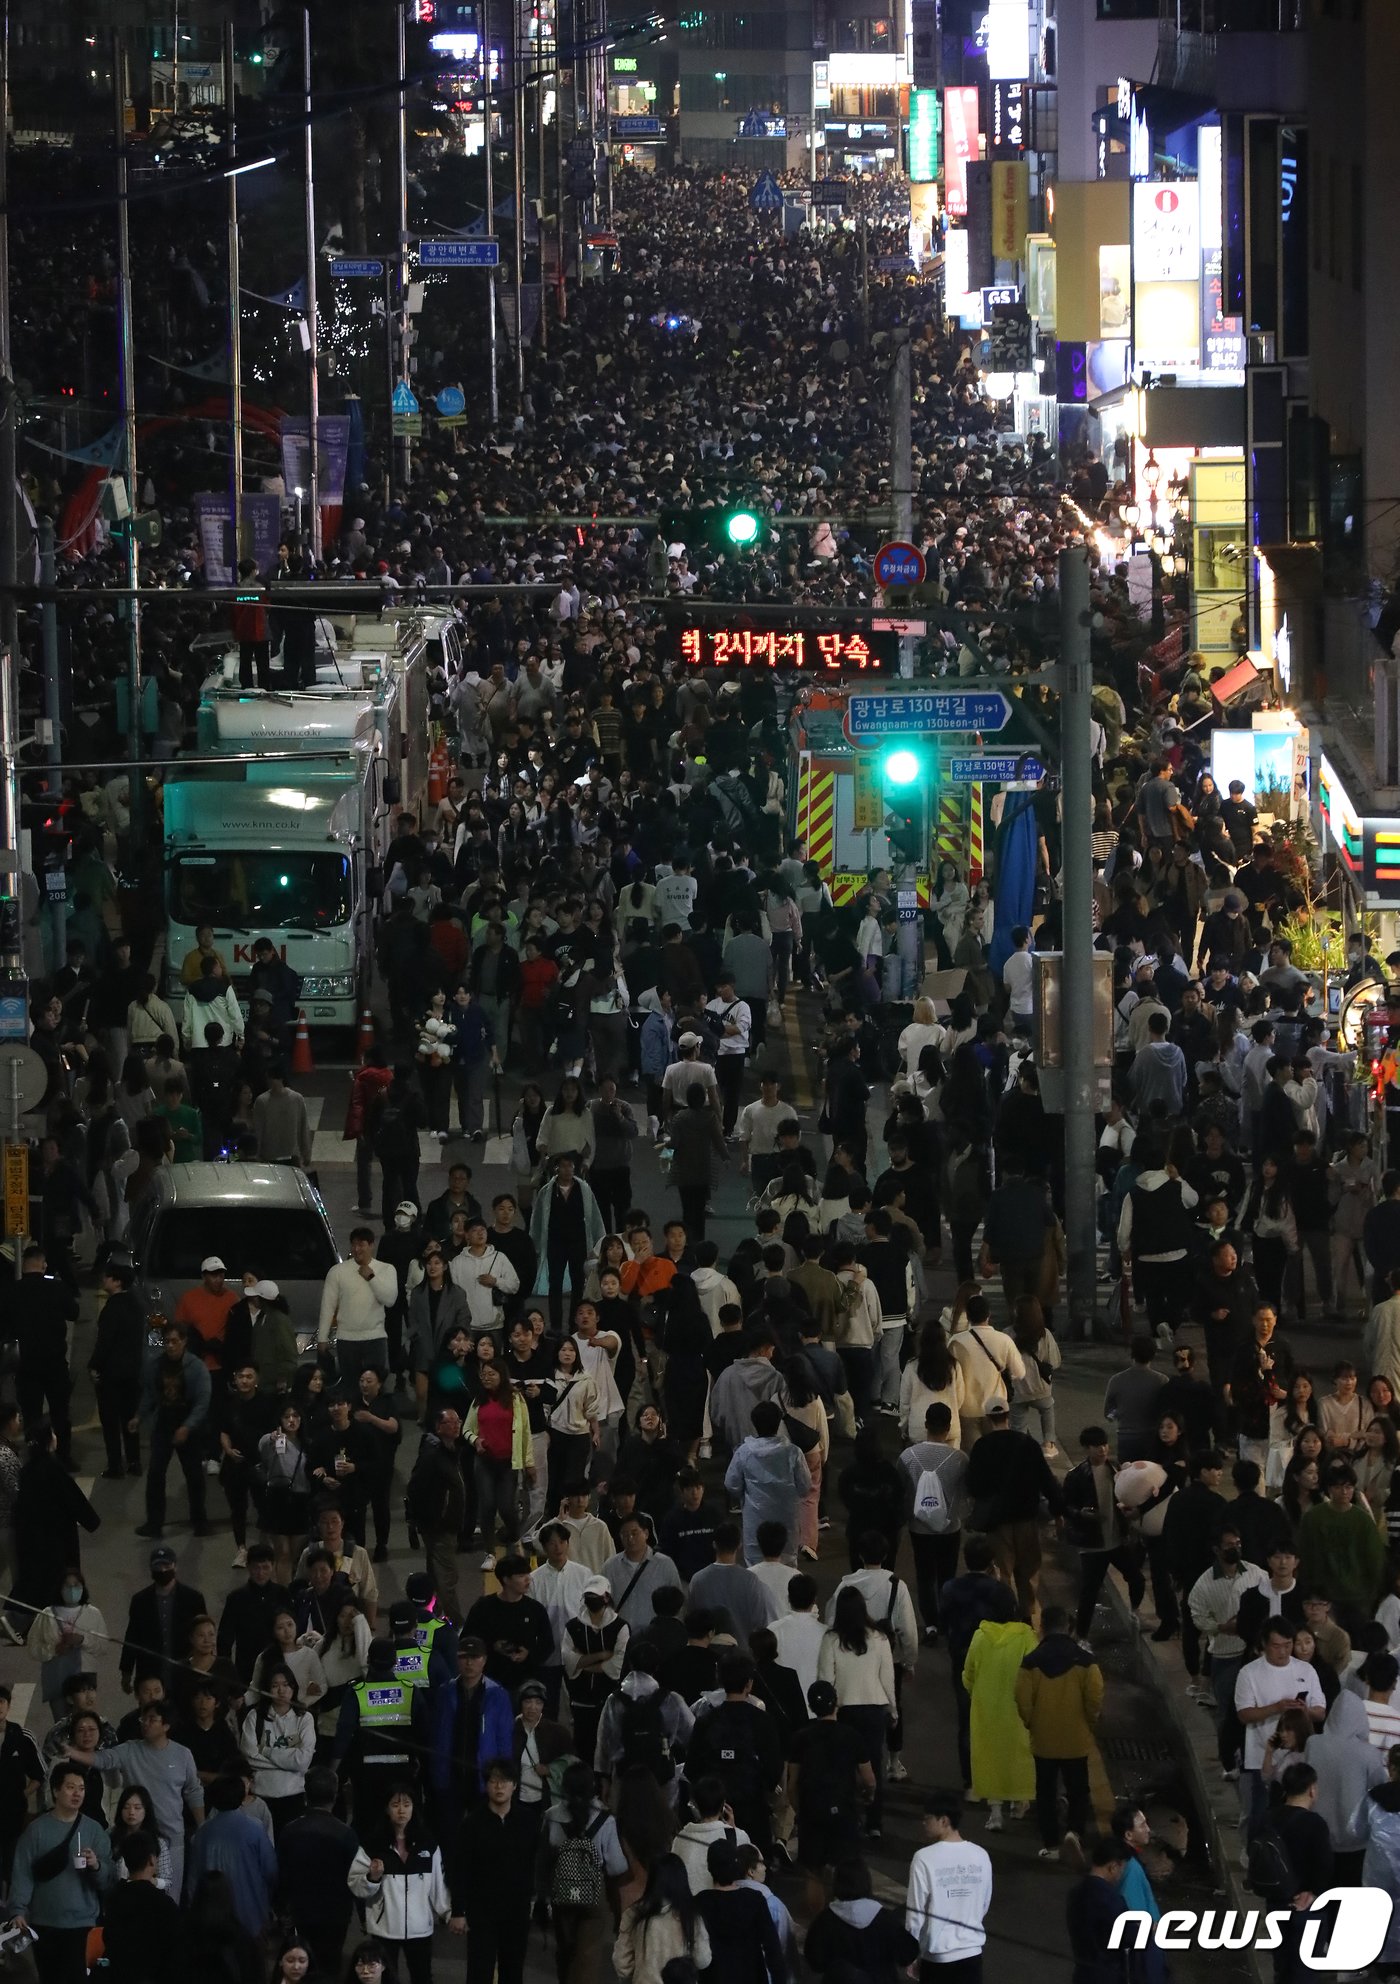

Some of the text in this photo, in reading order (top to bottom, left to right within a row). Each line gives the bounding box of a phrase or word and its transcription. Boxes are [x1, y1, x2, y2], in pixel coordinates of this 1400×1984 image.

[428, 245, 478, 257] 광안해변로
[988, 291, 1011, 304] GS
[882, 564, 917, 574] 주정차금지
[714, 630, 803, 666] 2시까지
[817, 634, 880, 668] 단속.
[855, 717, 985, 731] Gwangnam-ro 130beon-gil
[954, 761, 1015, 772] 광남로130번길
[999, 772, 1037, 780] 130bn-gil
[222, 821, 300, 829] www.knn.co.kr
[49, 892, 67, 901] 208
[900, 910, 917, 919] 207
